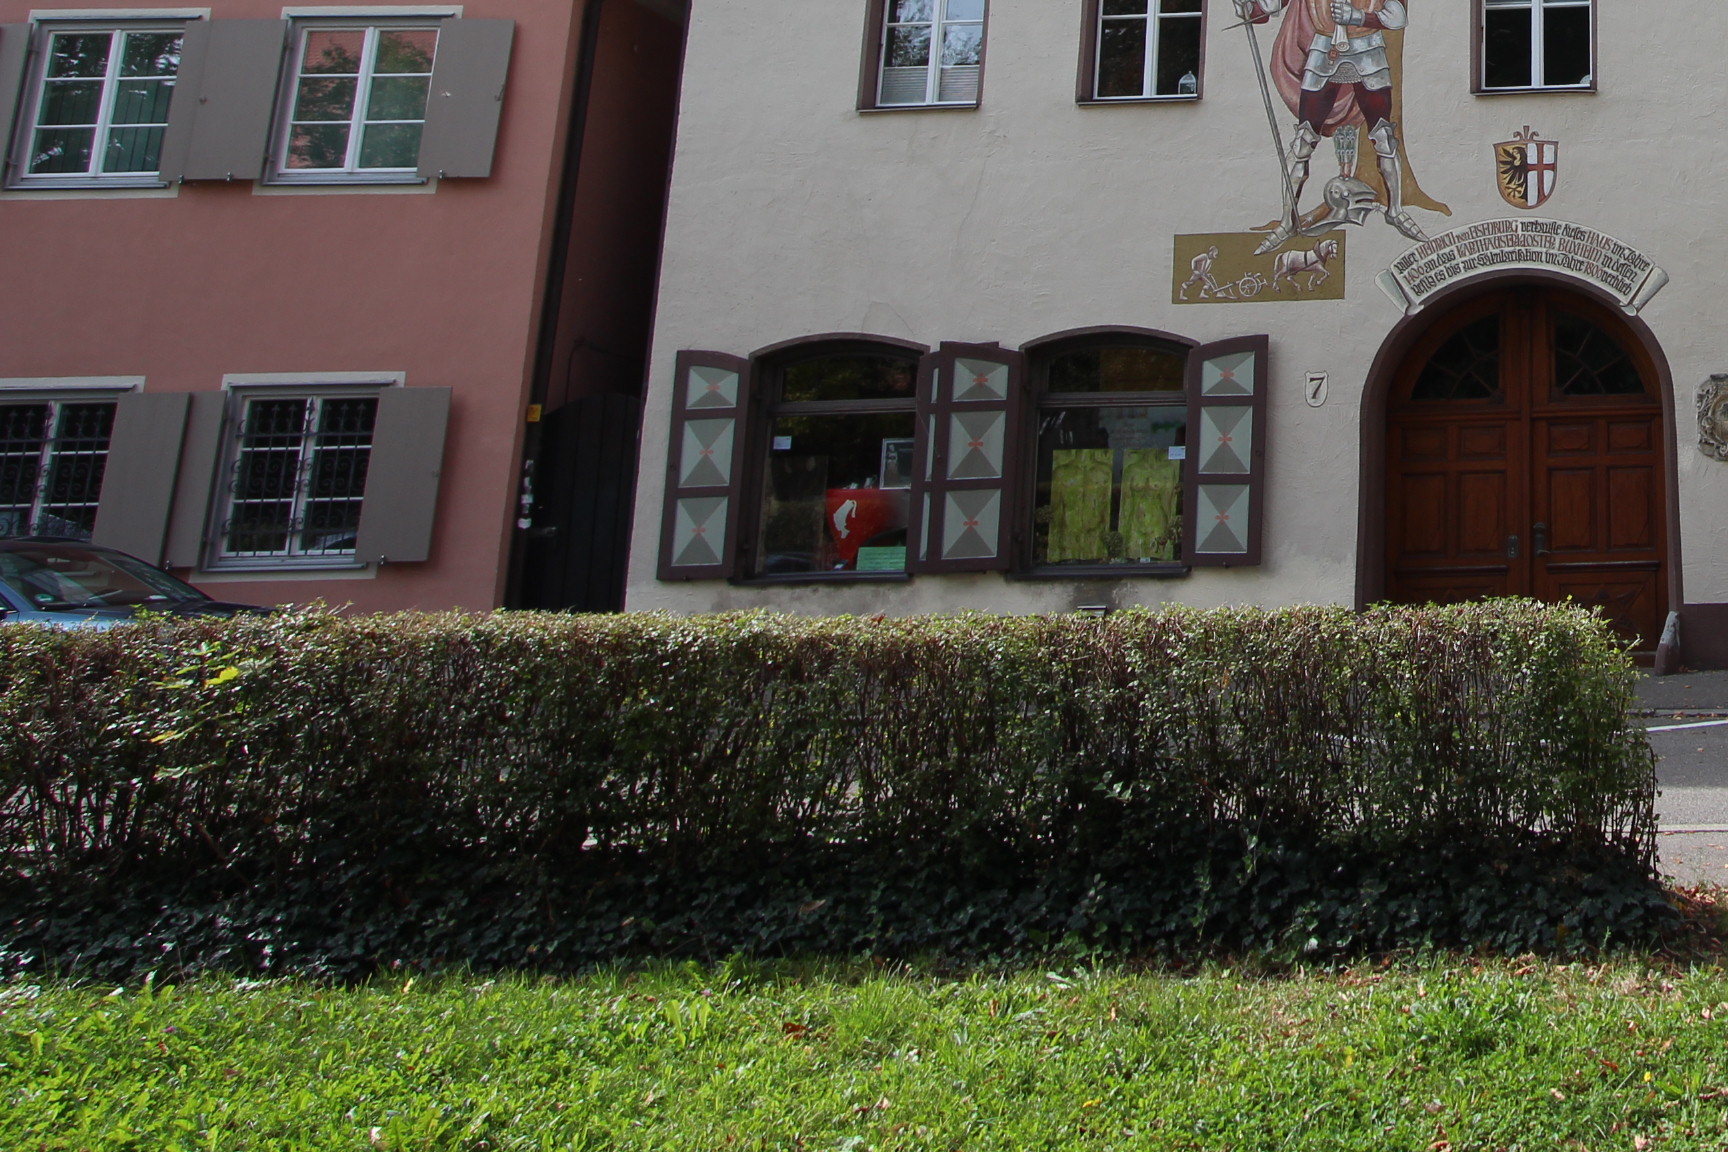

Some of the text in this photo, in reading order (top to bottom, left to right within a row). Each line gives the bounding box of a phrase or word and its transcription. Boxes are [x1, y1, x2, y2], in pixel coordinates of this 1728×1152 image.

[1416, 232, 1456, 260] HEINRICH
[1585, 231, 1614, 252] HAUS
[1622, 247, 1650, 271] Jahre
[1558, 237, 1603, 263] BUXHEIM
[1444, 261, 1461, 278] bis
[1557, 252, 1585, 272] Jahre
[1308, 377, 1326, 399] 7
